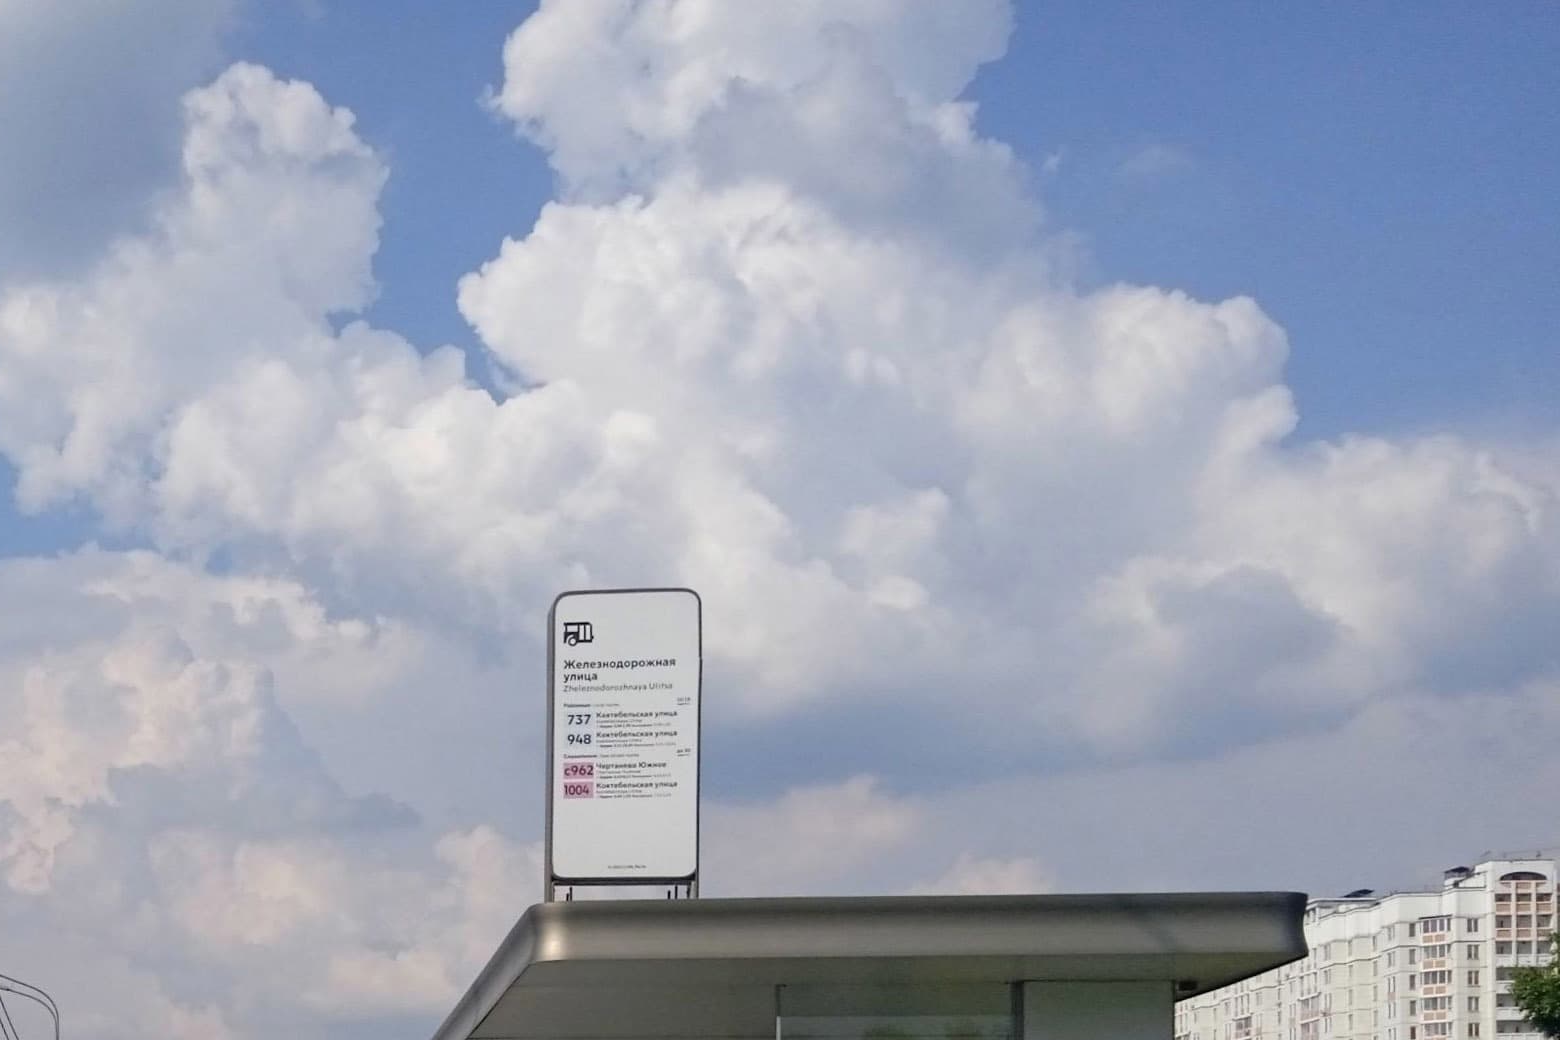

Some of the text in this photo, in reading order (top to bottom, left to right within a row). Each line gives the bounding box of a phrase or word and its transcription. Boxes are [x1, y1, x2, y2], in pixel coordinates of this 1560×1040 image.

[563, 659, 676, 669] Железнодорожная
[563, 672, 598, 683] улица
[567, 714, 592, 725] 737
[567, 734, 592, 745] 948
[563, 785, 590, 796] 1004
